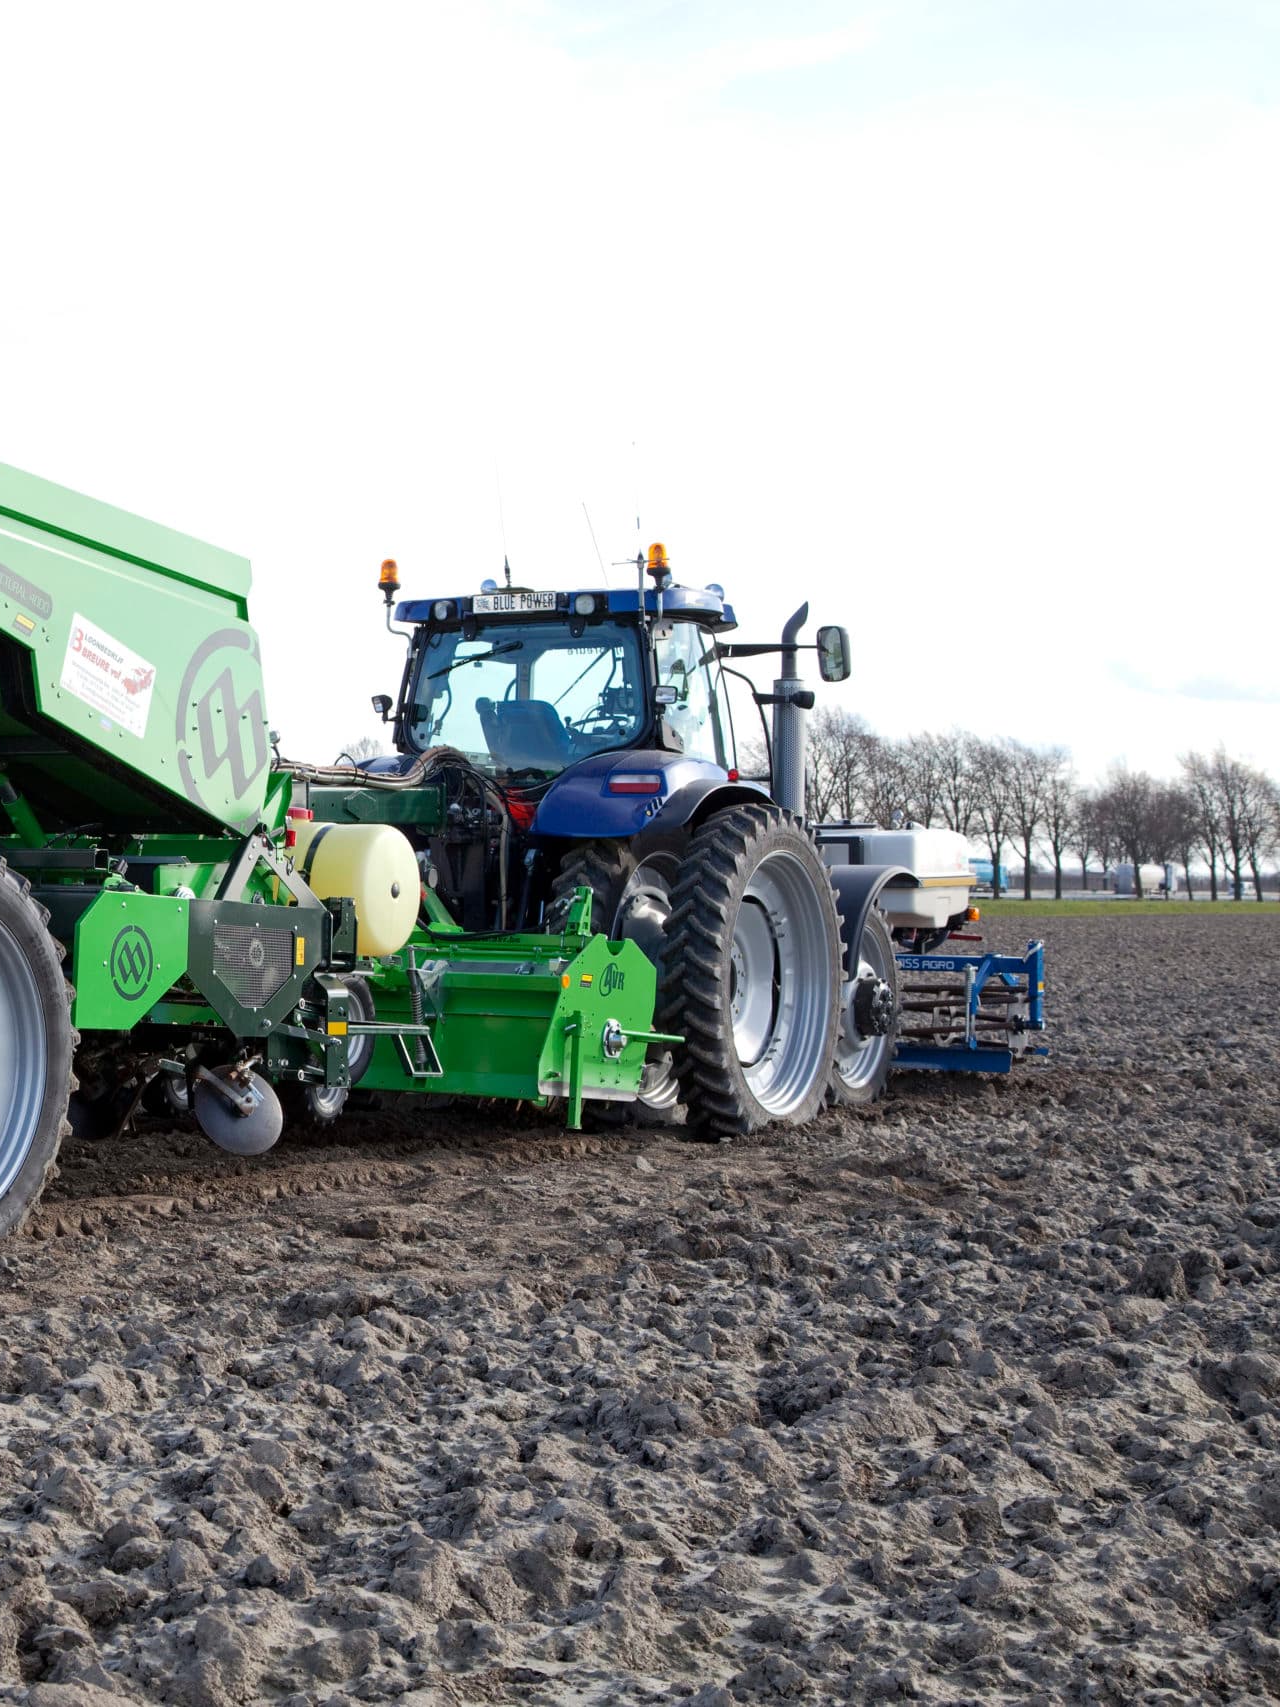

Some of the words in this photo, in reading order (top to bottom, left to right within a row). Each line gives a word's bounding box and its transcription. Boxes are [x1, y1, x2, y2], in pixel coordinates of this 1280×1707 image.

[493, 594, 516, 611] BLUE
[520, 592, 554, 609] POWER
[81, 646, 111, 673] BREURE
[921, 960, 955, 970] AGRO
